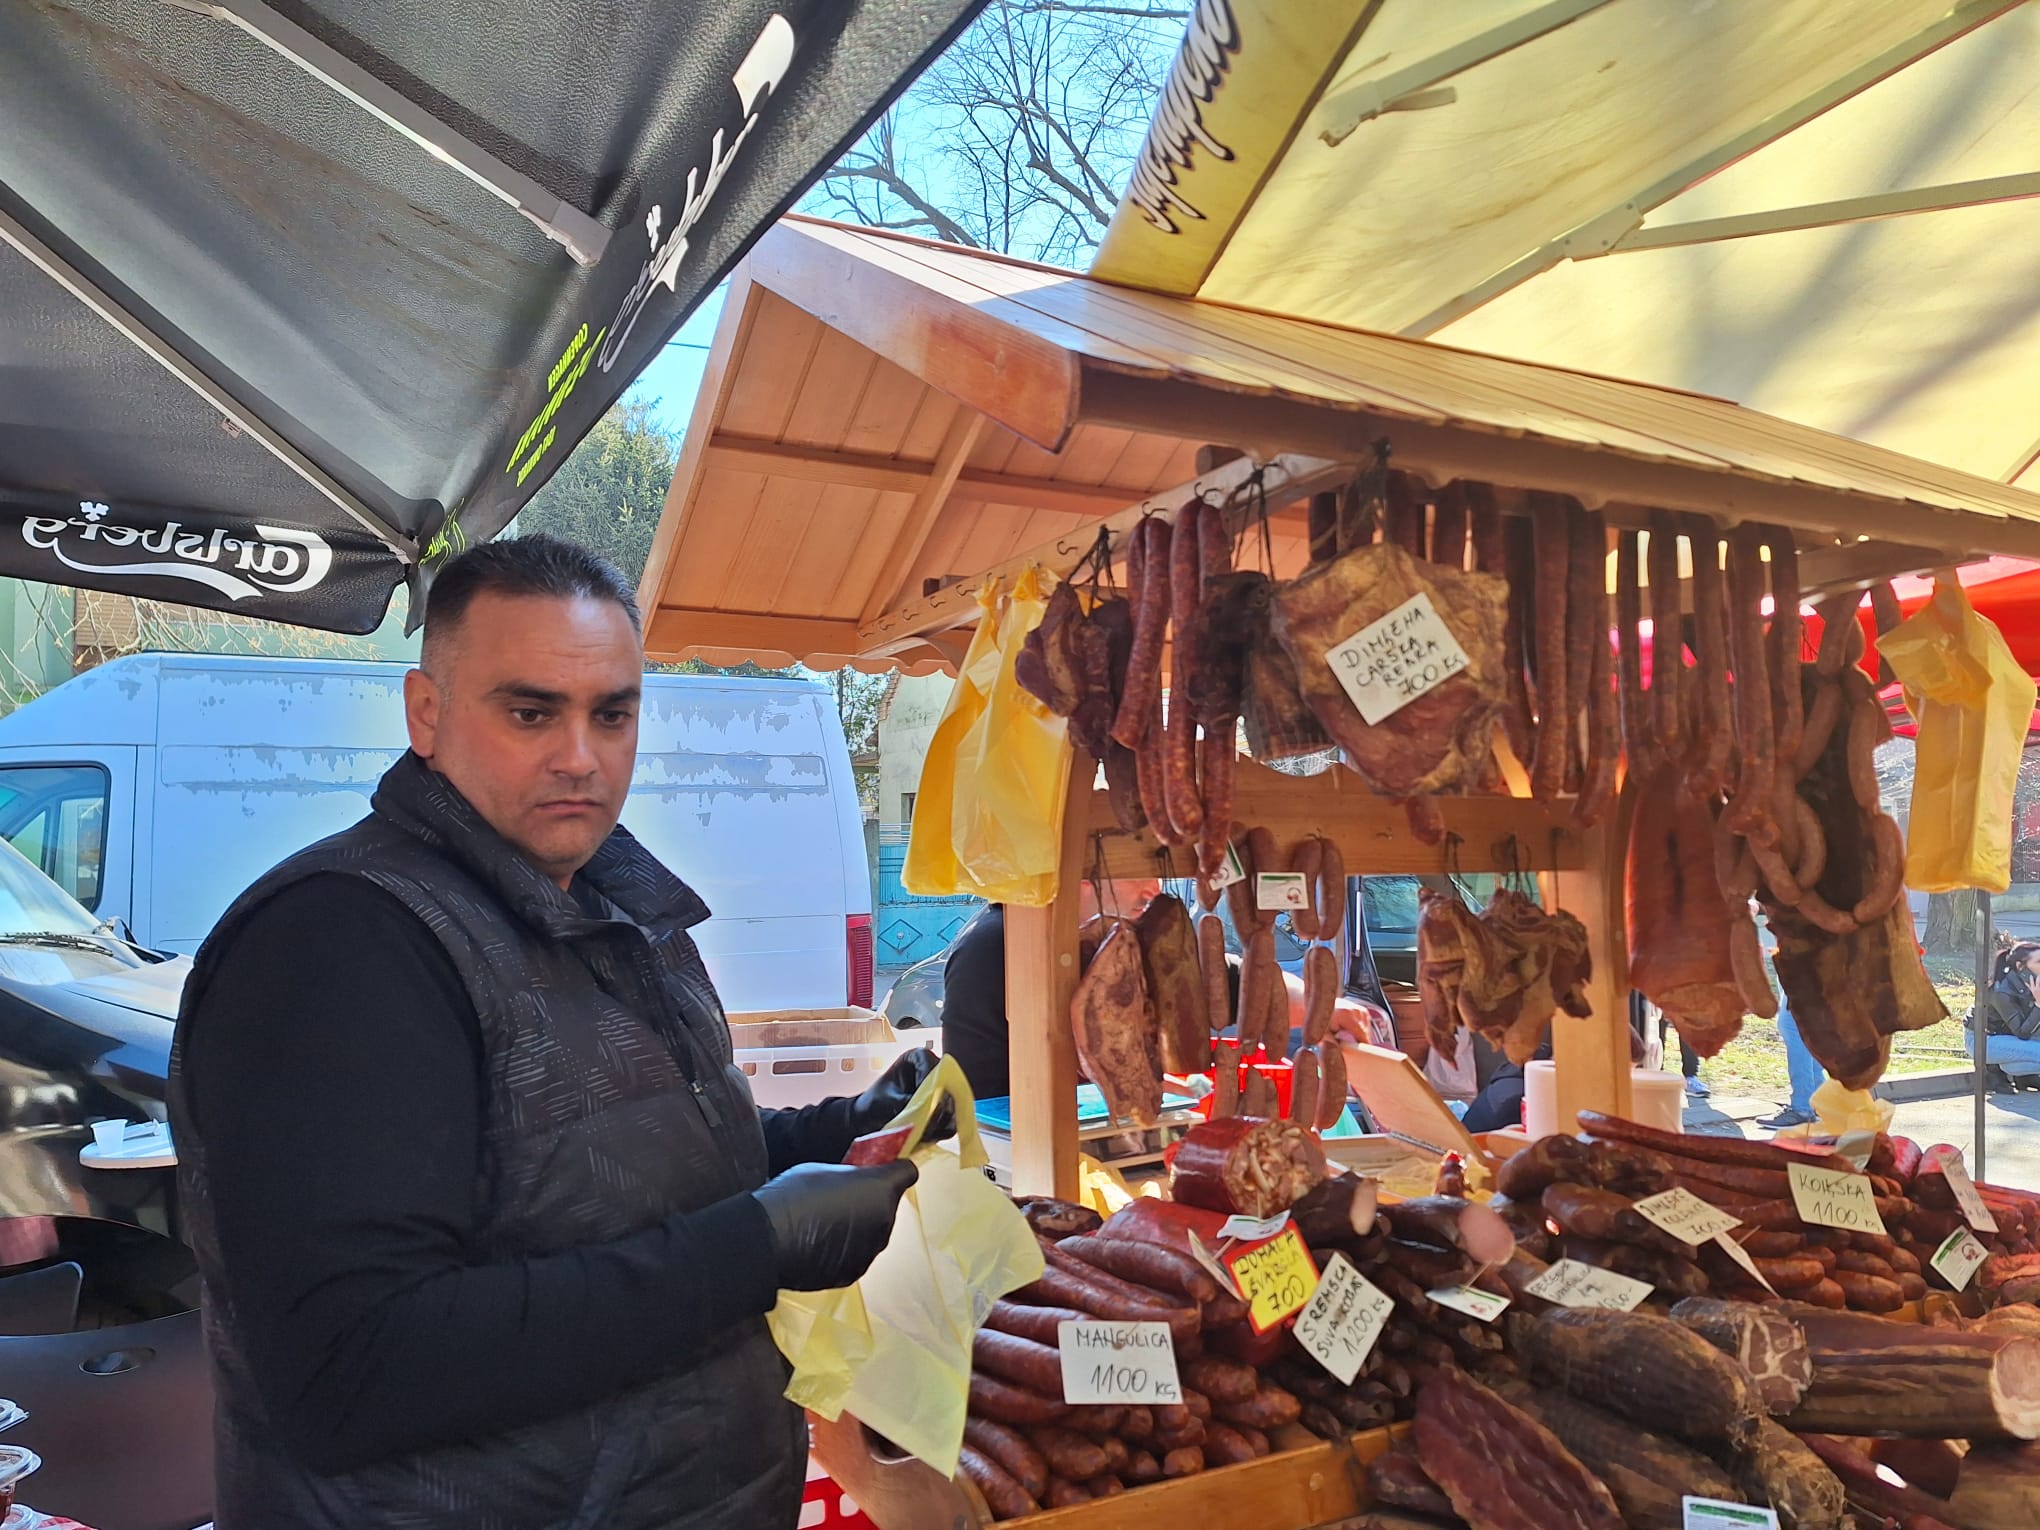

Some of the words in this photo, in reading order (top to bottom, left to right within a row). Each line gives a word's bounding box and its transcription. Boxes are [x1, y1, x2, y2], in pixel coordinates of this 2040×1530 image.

[1397, 663, 1438, 696] 700
[1813, 1201, 1858, 1226] 1100
[1267, 1274, 1306, 1313] 700
[1341, 1308, 1374, 1356] 1200
[1090, 1363, 1148, 1395] 1100
